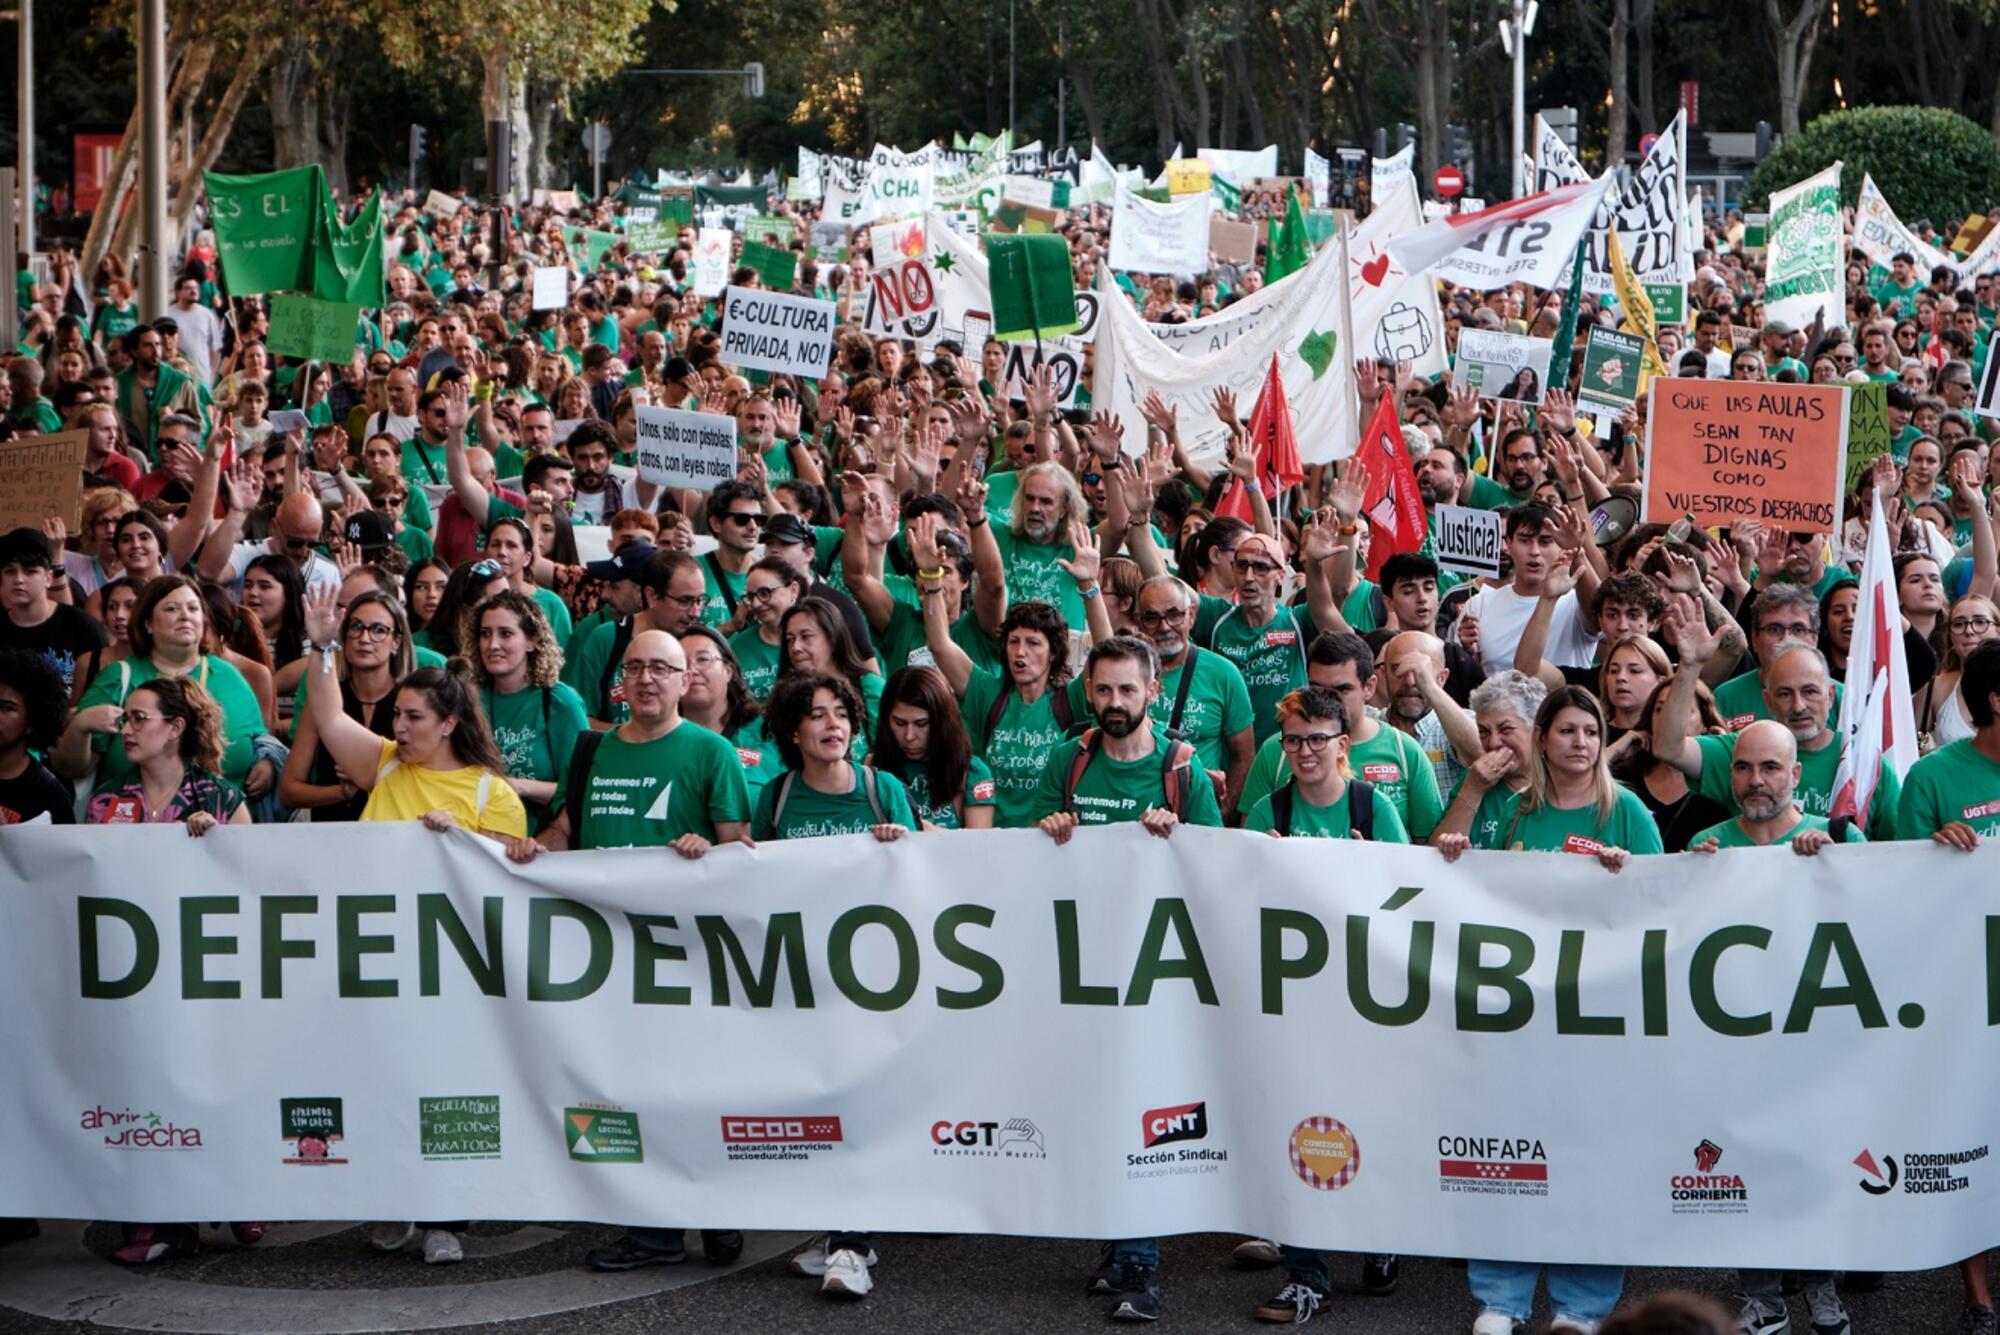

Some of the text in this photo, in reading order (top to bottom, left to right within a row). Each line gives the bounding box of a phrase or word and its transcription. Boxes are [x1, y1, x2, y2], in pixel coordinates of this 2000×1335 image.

[873, 259, 934, 322] NO
[729, 299, 829, 333] €-CULTURA
[725, 331, 826, 365] PRIVADA, NO!
[1005, 344, 1078, 402] NO
[1672, 393, 1825, 420] QUE LAS AULAS
[1851, 385, 1879, 415] ÓN
[639, 417, 733, 449] Unos, sólo con pistolas;
[1693, 422, 1794, 443] SEAN TAN
[1851, 416, 1887, 435] MA
[1704, 443, 1787, 470] DIGNAS
[1847, 439, 1886, 456] CCIÓN
[640, 450, 734, 478] otros, con leyes roban.
[1713, 470, 1766, 487] COMO
[1665, 492, 1834, 526] VUESTROS DESPACHOS
[1438, 511, 1500, 560] Justicia!
[592, 776, 657, 788] Queremos FP
[591, 791, 628, 801] de todas
[1121, 798, 1137, 809] FP
[590, 805, 636, 818] para todas
[1964, 806, 1988, 819] UGT
[77, 893, 1004, 1012] DEFENDEMOS
[1053, 897, 1220, 1007] LA
[1260, 887, 1926, 1037] PÚBLICA.
[433, 1123, 449, 1135] DE
[727, 1122, 804, 1138] CCOO
[931, 1120, 999, 1146] CGT
[1151, 1113, 1198, 1136] CNT
[727, 1143, 833, 1153] educación y servicios
[728, 1152, 809, 1161] socioeducativos
[1127, 1149, 1228, 1166] Sección Sindical
[1438, 1136, 1547, 1160] CONFAPA
[1904, 1145, 1989, 1167] COORDINADORA
[1671, 1175, 1745, 1189] CONTRA
[1904, 1167, 1952, 1180] JUVENIL
[1463, 1186, 1506, 1195] COMUNIDAD
[1519, 1189, 1549, 1197] MADRID
[1671, 1189, 1747, 1201] CORRIENTE
[1904, 1177, 1969, 1194] SOCIALISTA
